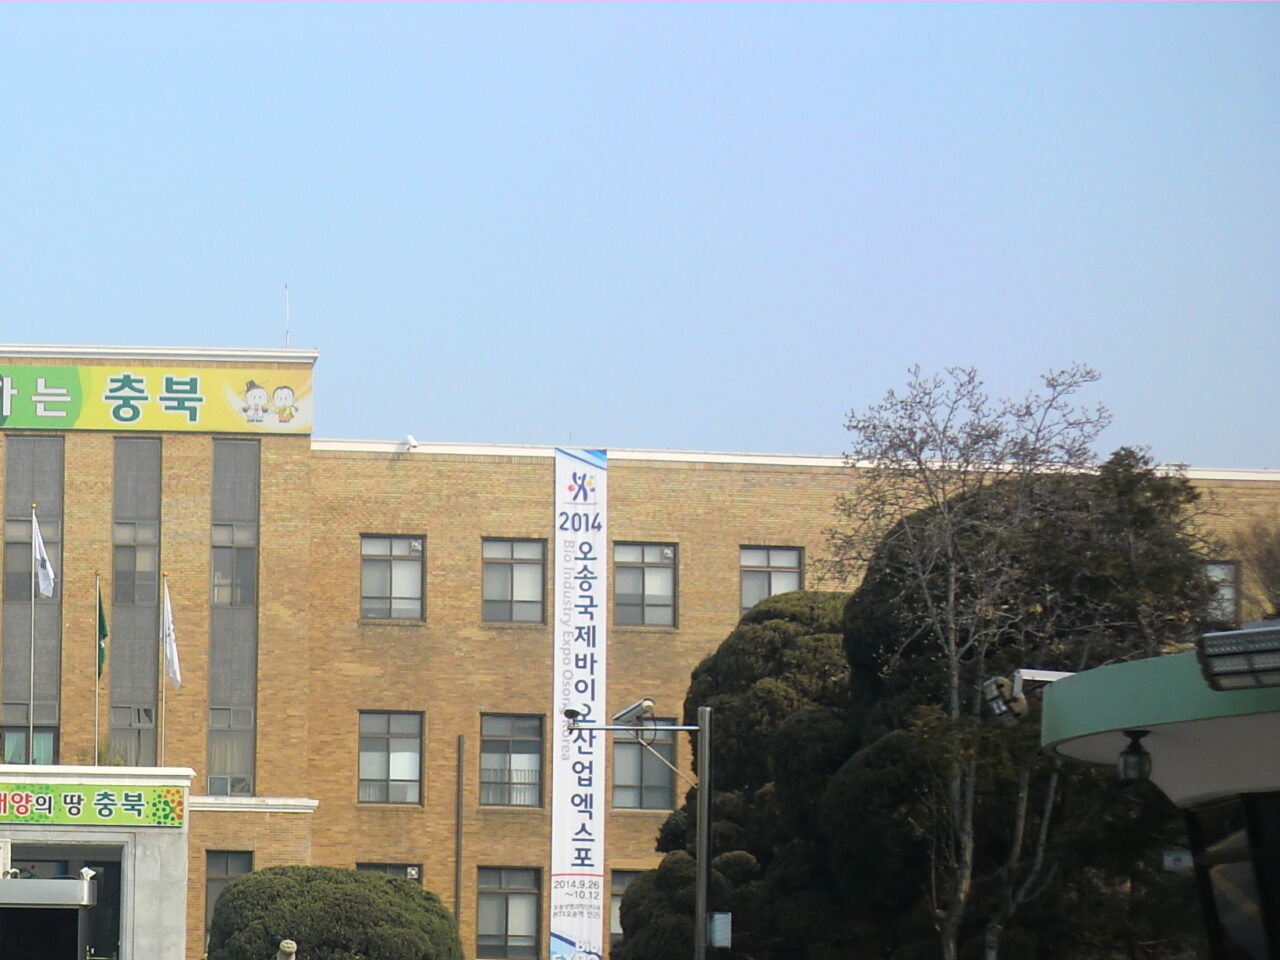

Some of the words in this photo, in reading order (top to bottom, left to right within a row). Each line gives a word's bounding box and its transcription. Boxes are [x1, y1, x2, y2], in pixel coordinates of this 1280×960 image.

[102, 372, 208, 425] 충북
[559, 511, 603, 533] 2014
[563, 540, 576, 563] Bio
[560, 567, 576, 627] Industry
[560, 631, 575, 666] Expo
[63, 792, 85, 817] 땅
[94, 791, 146, 818] 충북
[553, 879, 600, 890] 2014.9.26
